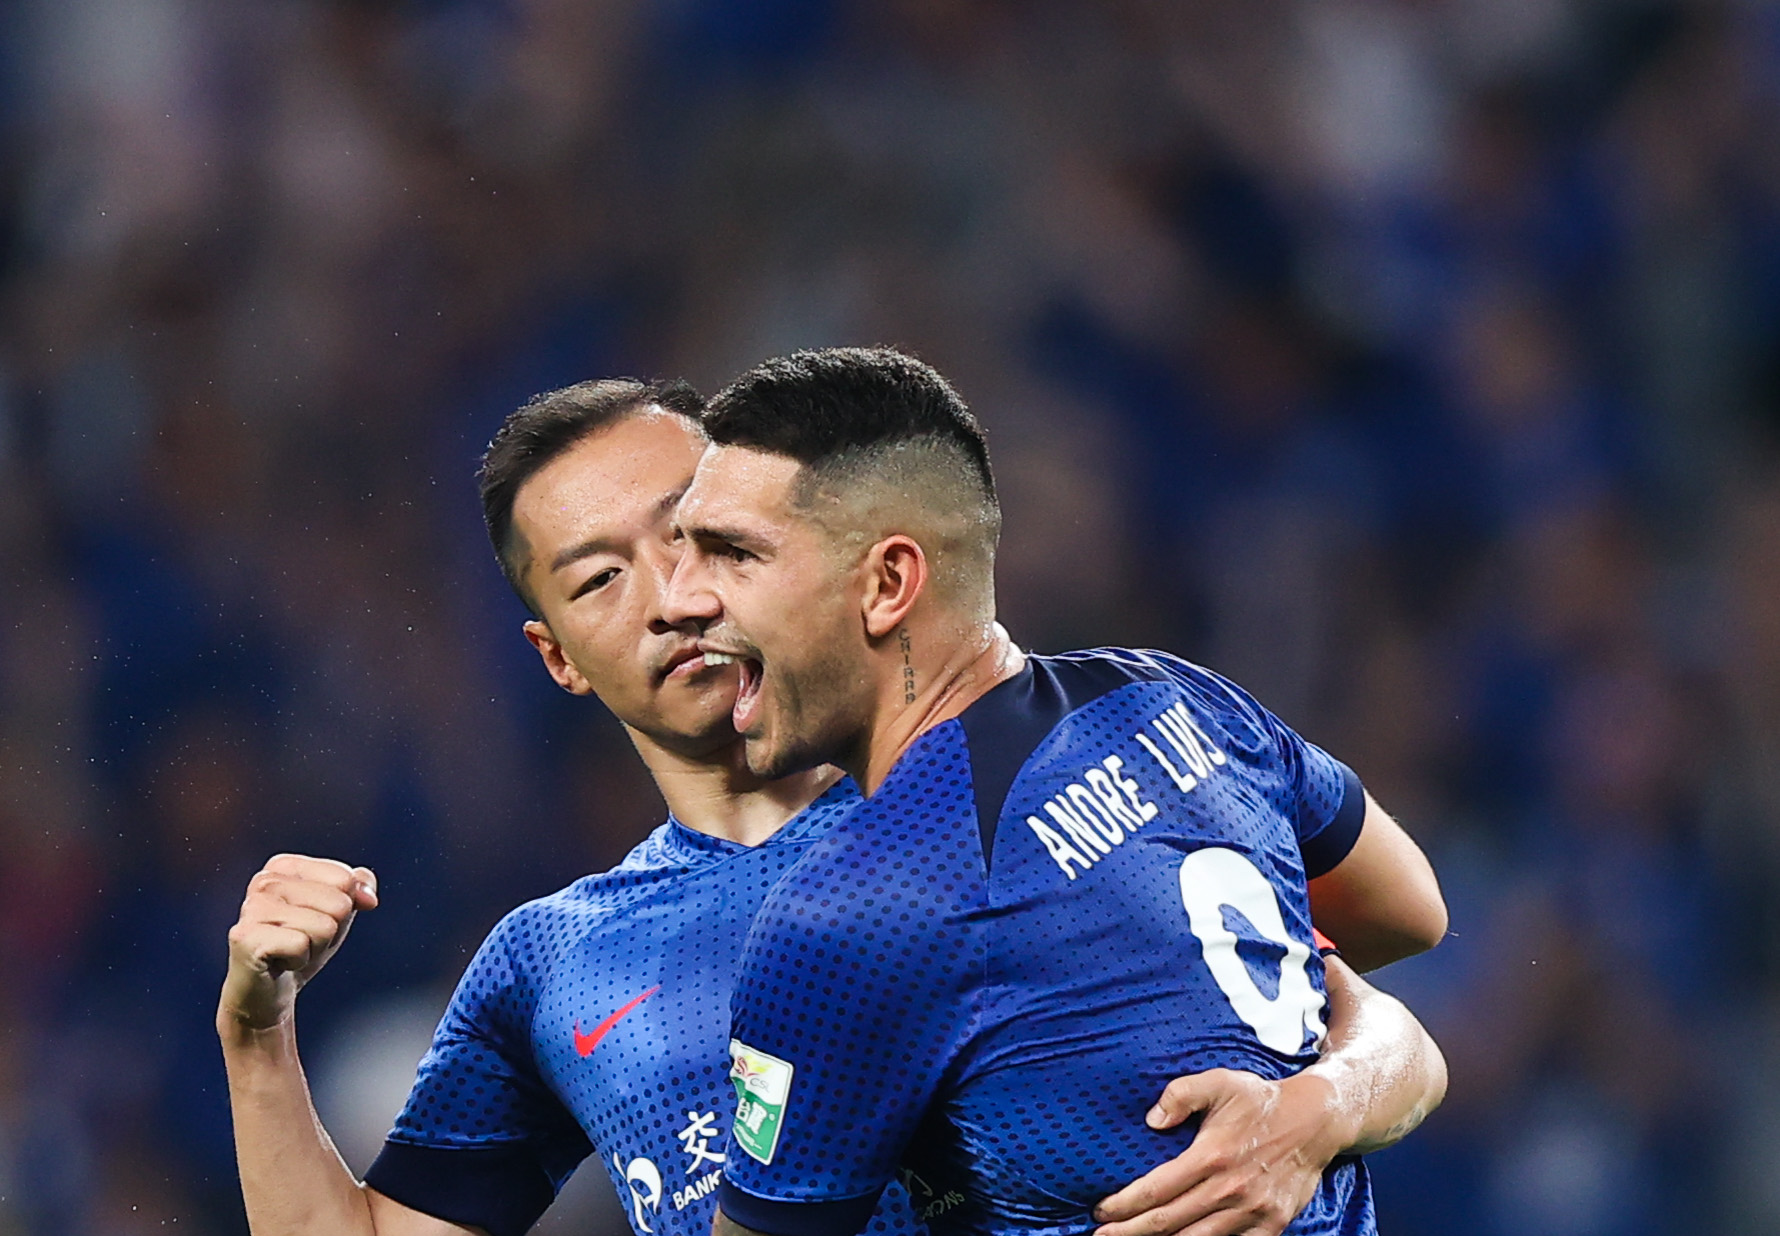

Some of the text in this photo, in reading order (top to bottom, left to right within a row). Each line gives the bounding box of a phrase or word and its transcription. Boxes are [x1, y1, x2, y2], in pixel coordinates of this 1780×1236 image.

[1026, 701, 1227, 880] ANDRE LUIS
[672, 1169, 722, 1211] BANK
